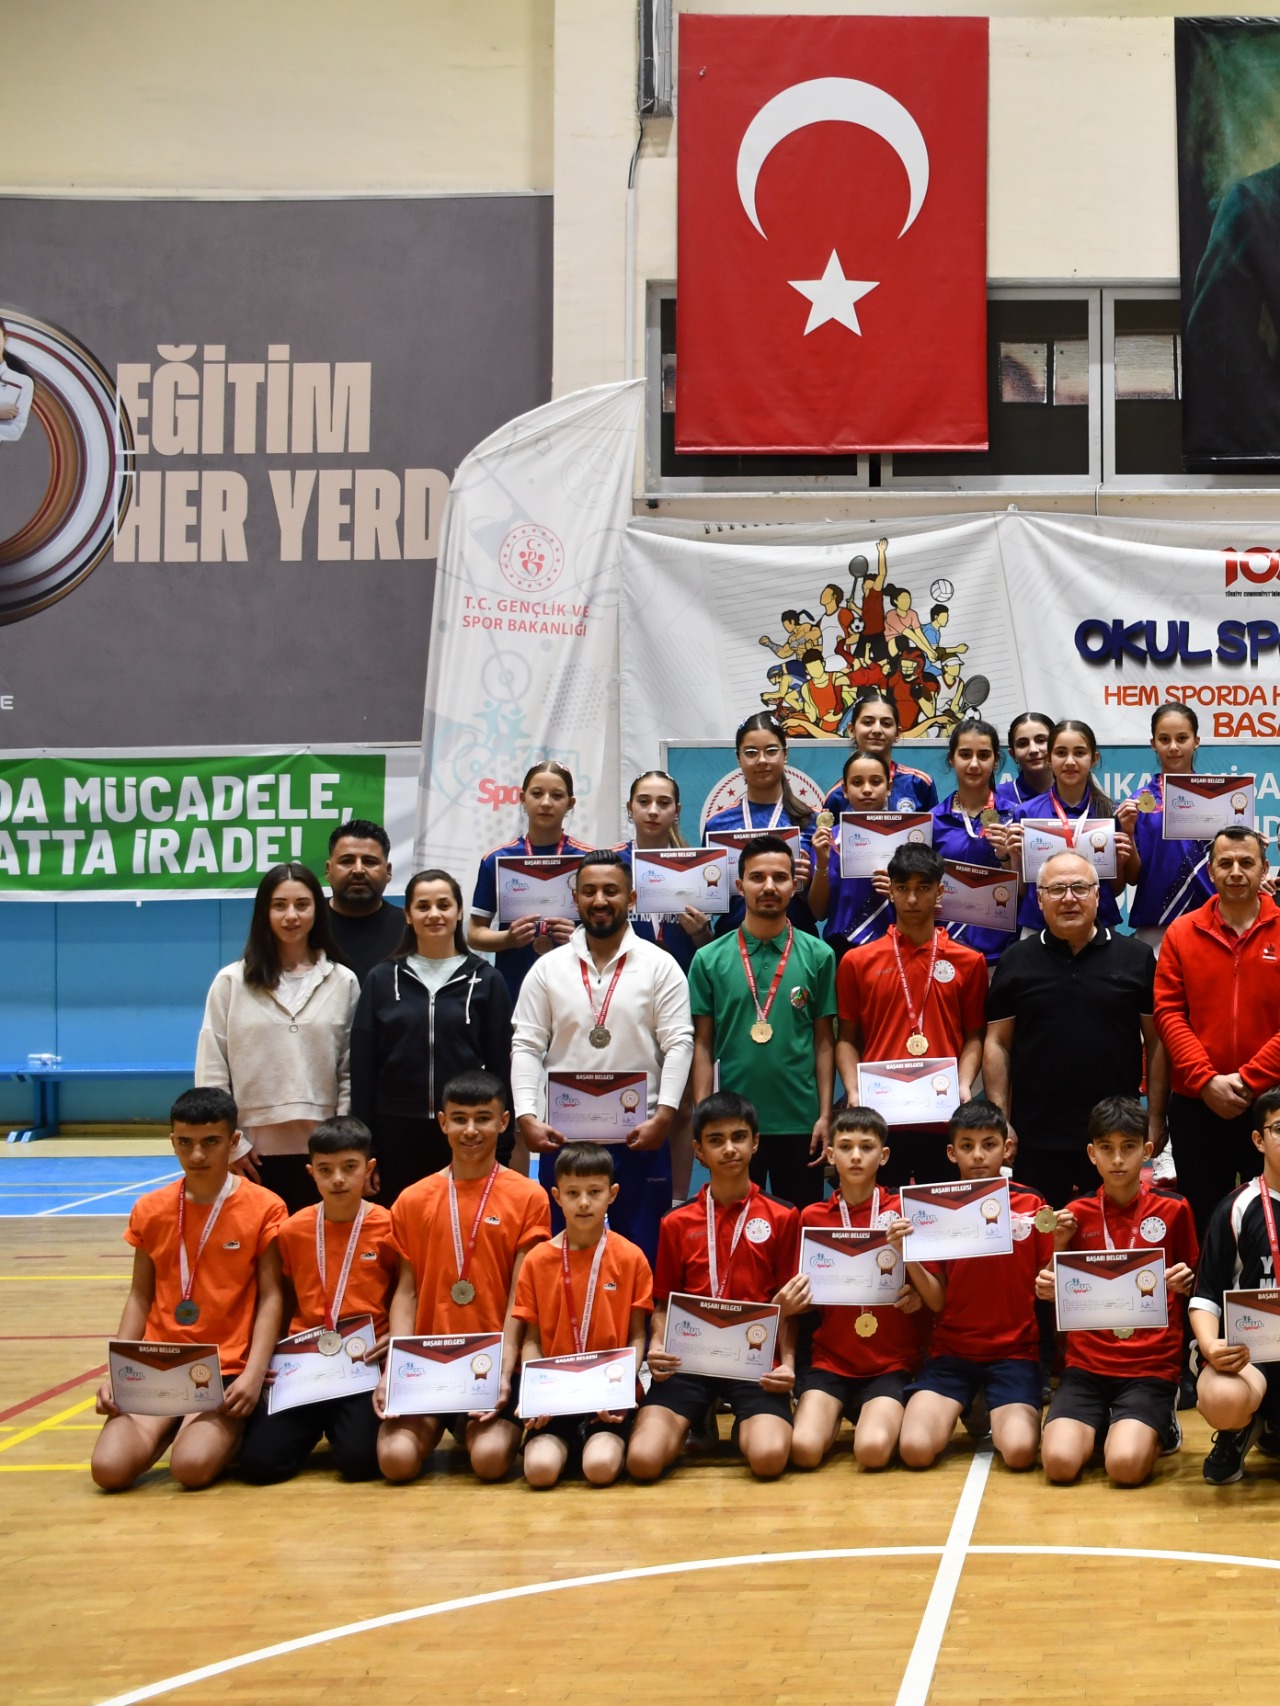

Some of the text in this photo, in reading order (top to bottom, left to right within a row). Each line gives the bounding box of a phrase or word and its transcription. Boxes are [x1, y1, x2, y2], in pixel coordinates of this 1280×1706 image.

[115, 344, 372, 457] EĞİTİM
[113, 468, 460, 564] HER YERD
[462, 615, 588, 637] SPOR BAKANLIĞI
[464, 596, 590, 618] T.C. GENÇLİK VE
[1074, 617, 1213, 664] OKUL
[1104, 685, 1160, 706] HEM
[1165, 684, 1268, 706] SPORDA
[64, 773, 353, 824] MÜCADELE,
[133, 826, 304, 874] İRADE!
